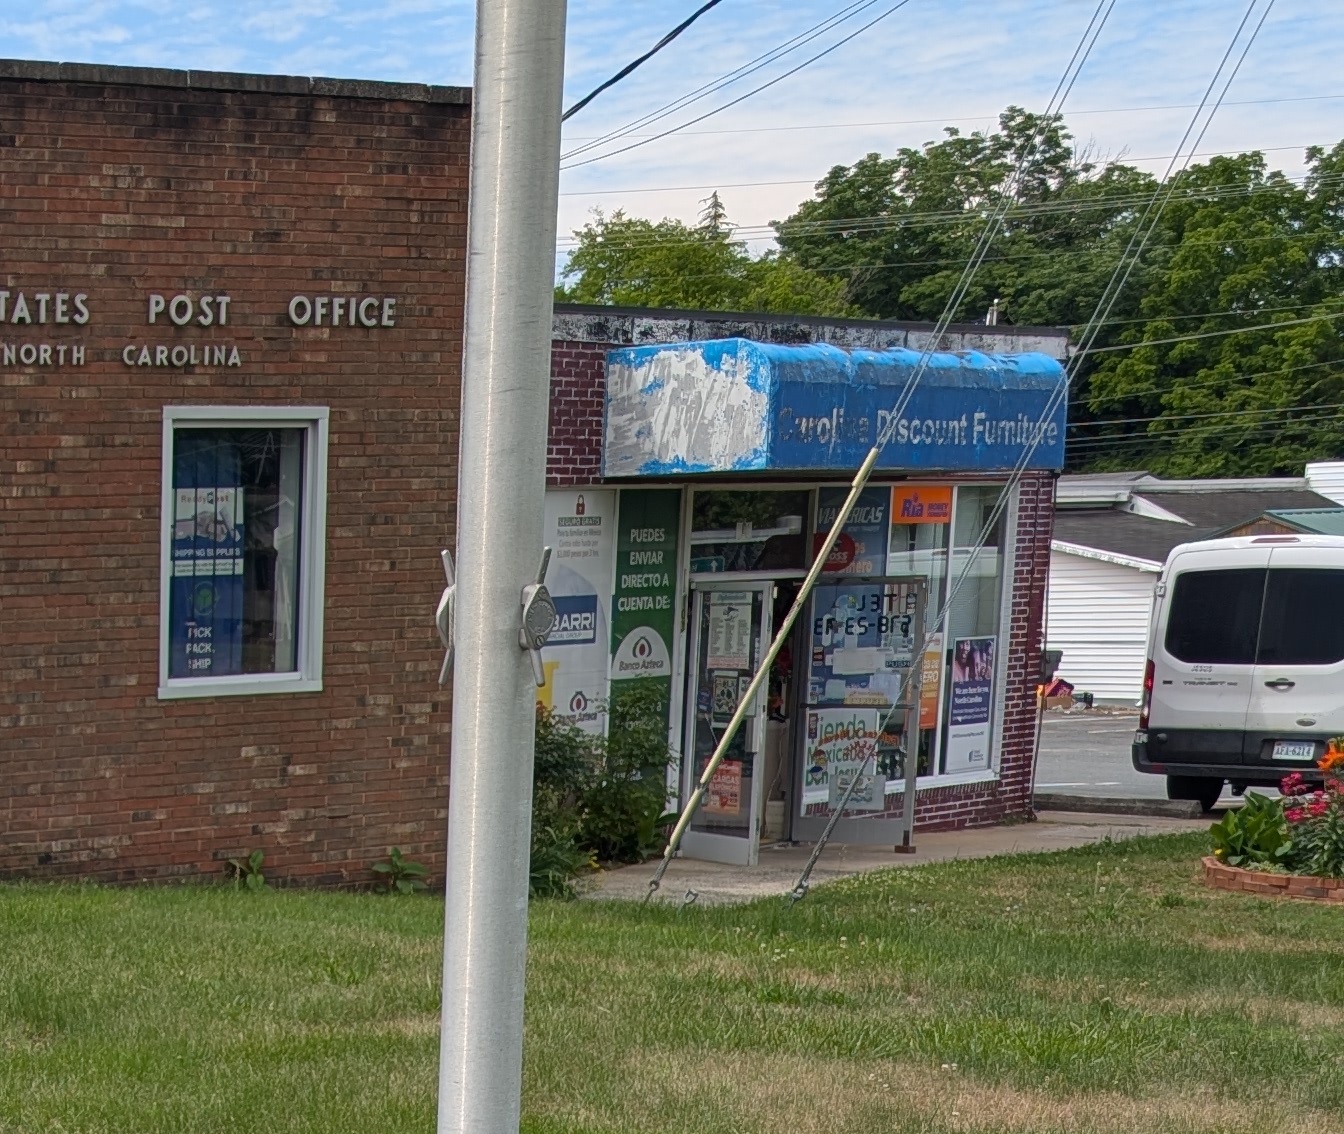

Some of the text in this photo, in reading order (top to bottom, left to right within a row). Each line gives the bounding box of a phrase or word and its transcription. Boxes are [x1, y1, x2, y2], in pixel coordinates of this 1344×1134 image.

[148, 294, 231, 326] POST
[289, 295, 397, 327] OFFICE
[3, 344, 85, 366] NORTH
[122, 344, 242, 367] CAROLINA
[877, 409, 968, 445] Discount
[973, 412, 1059, 445] Furniture
[819, 506, 884, 524] VIAERICAS
[630, 528, 665, 543] PUEDES
[630, 551, 663, 565] ENVIAR
[621, 573, 669, 588] DIRECTO A
[618, 596, 653, 611] CUENTA
[619, 660, 664, 671] Banco Azteca
[811, 714, 865, 740] ienda
